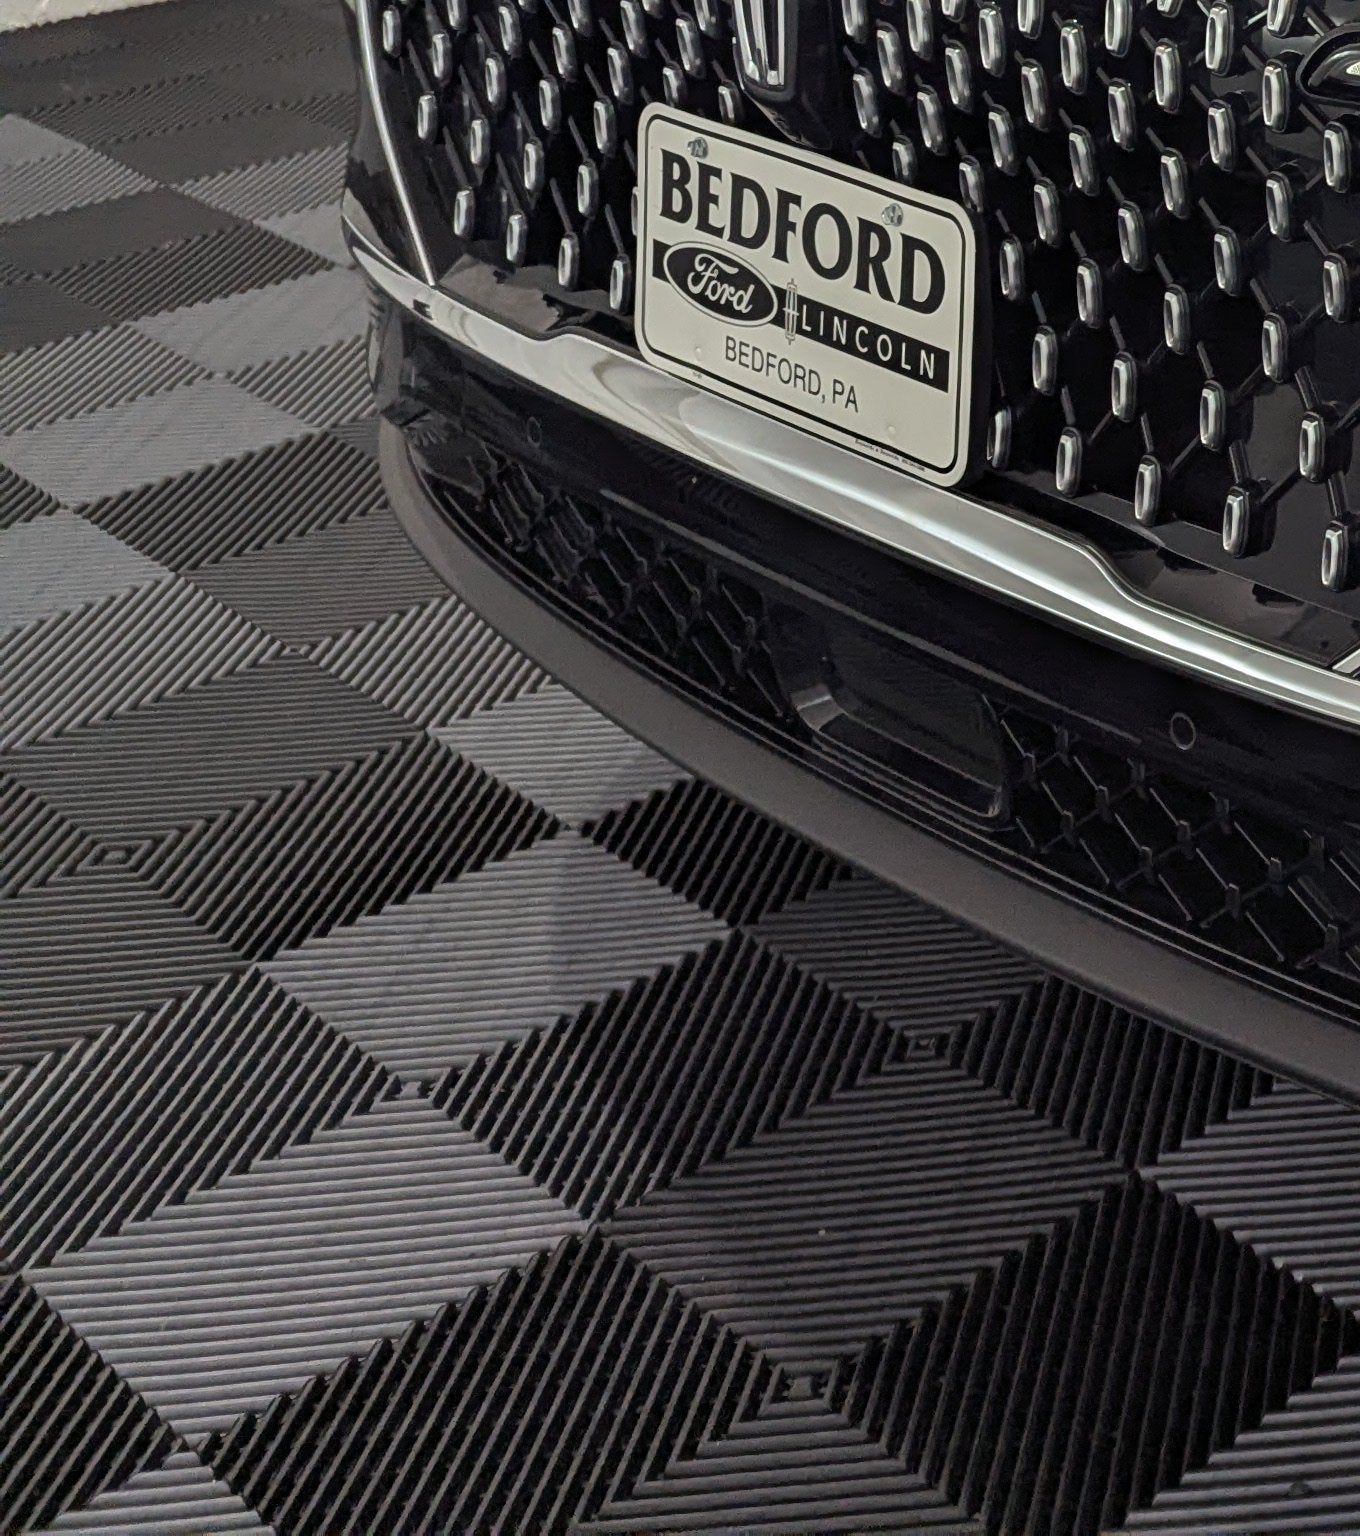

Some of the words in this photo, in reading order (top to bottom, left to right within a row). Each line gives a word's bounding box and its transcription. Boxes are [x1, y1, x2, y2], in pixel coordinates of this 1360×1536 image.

[659, 148, 946, 315] BEDFORD
[687, 253, 754, 315] Ford
[725, 335, 826, 404] BEDFORD,
[833, 379, 859, 413] PA
[801, 304, 935, 380] LINCOLN
